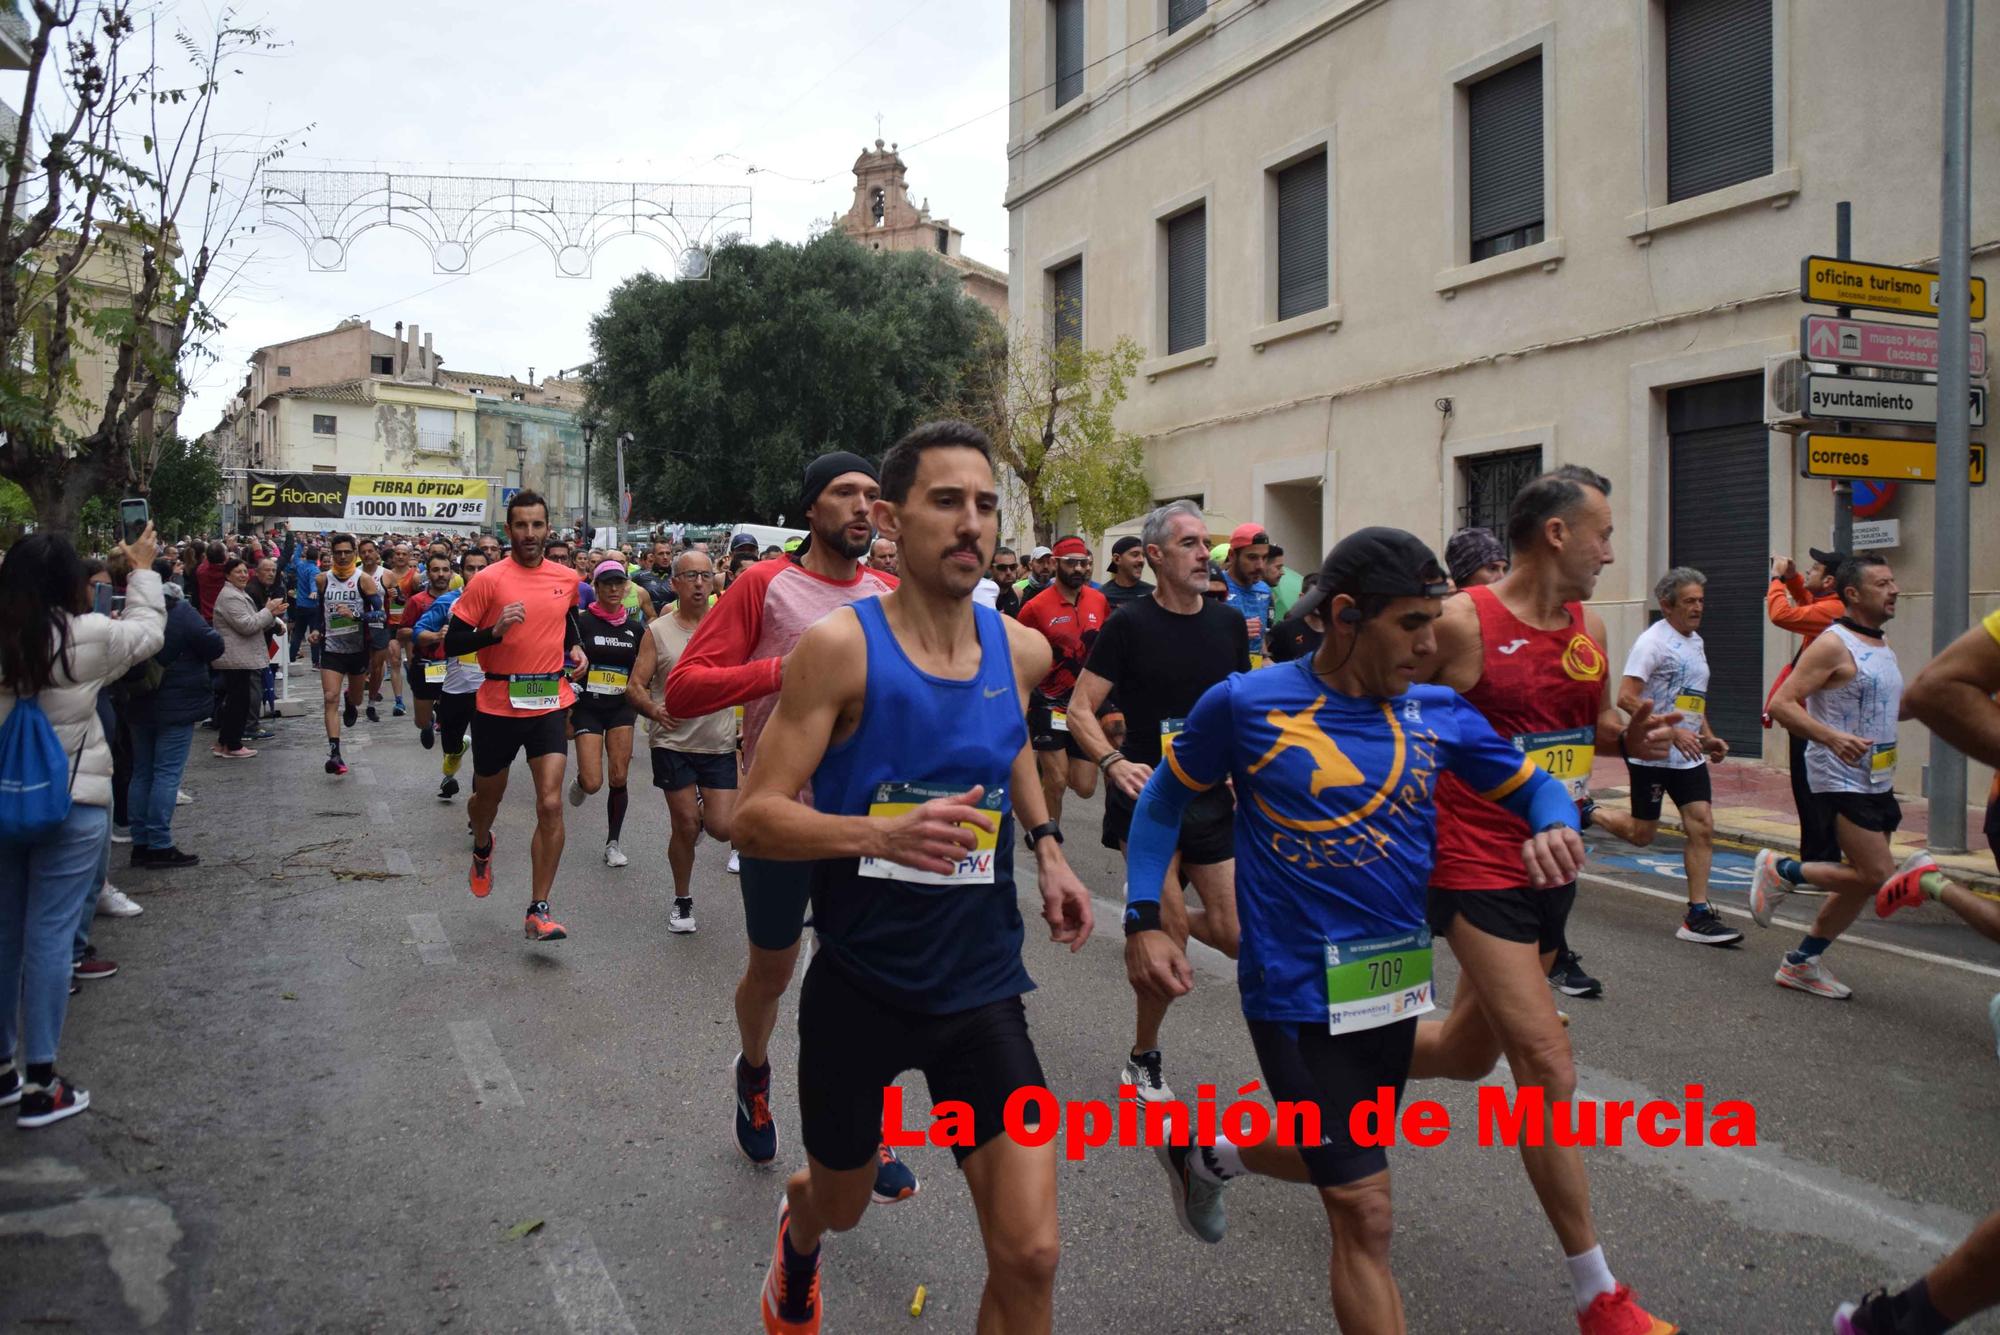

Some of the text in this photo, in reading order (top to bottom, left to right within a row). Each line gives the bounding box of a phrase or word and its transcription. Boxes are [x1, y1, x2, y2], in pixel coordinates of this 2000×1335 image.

[1816, 268, 1922, 295] oficina turismo
[1870, 333, 1937, 349] museo Medin
[1886, 346, 1928, 362] (acceso
[1812, 390, 1914, 411] ayuntamiento
[1812, 450, 1869, 466] correos
[372, 479, 464, 496] FIBRA ÓPTICA
[280, 488, 342, 504] fibranet
[356, 501, 397, 516] 1000
[401, 502, 427, 517] Mb
[327, 590, 356, 601] UNED
[602, 672, 615, 683] 106
[526, 682, 543, 694] 804
[1545, 748, 1574, 774] 219
[1271, 824, 1399, 869] CIEZA
[1368, 957, 1403, 990] 709
